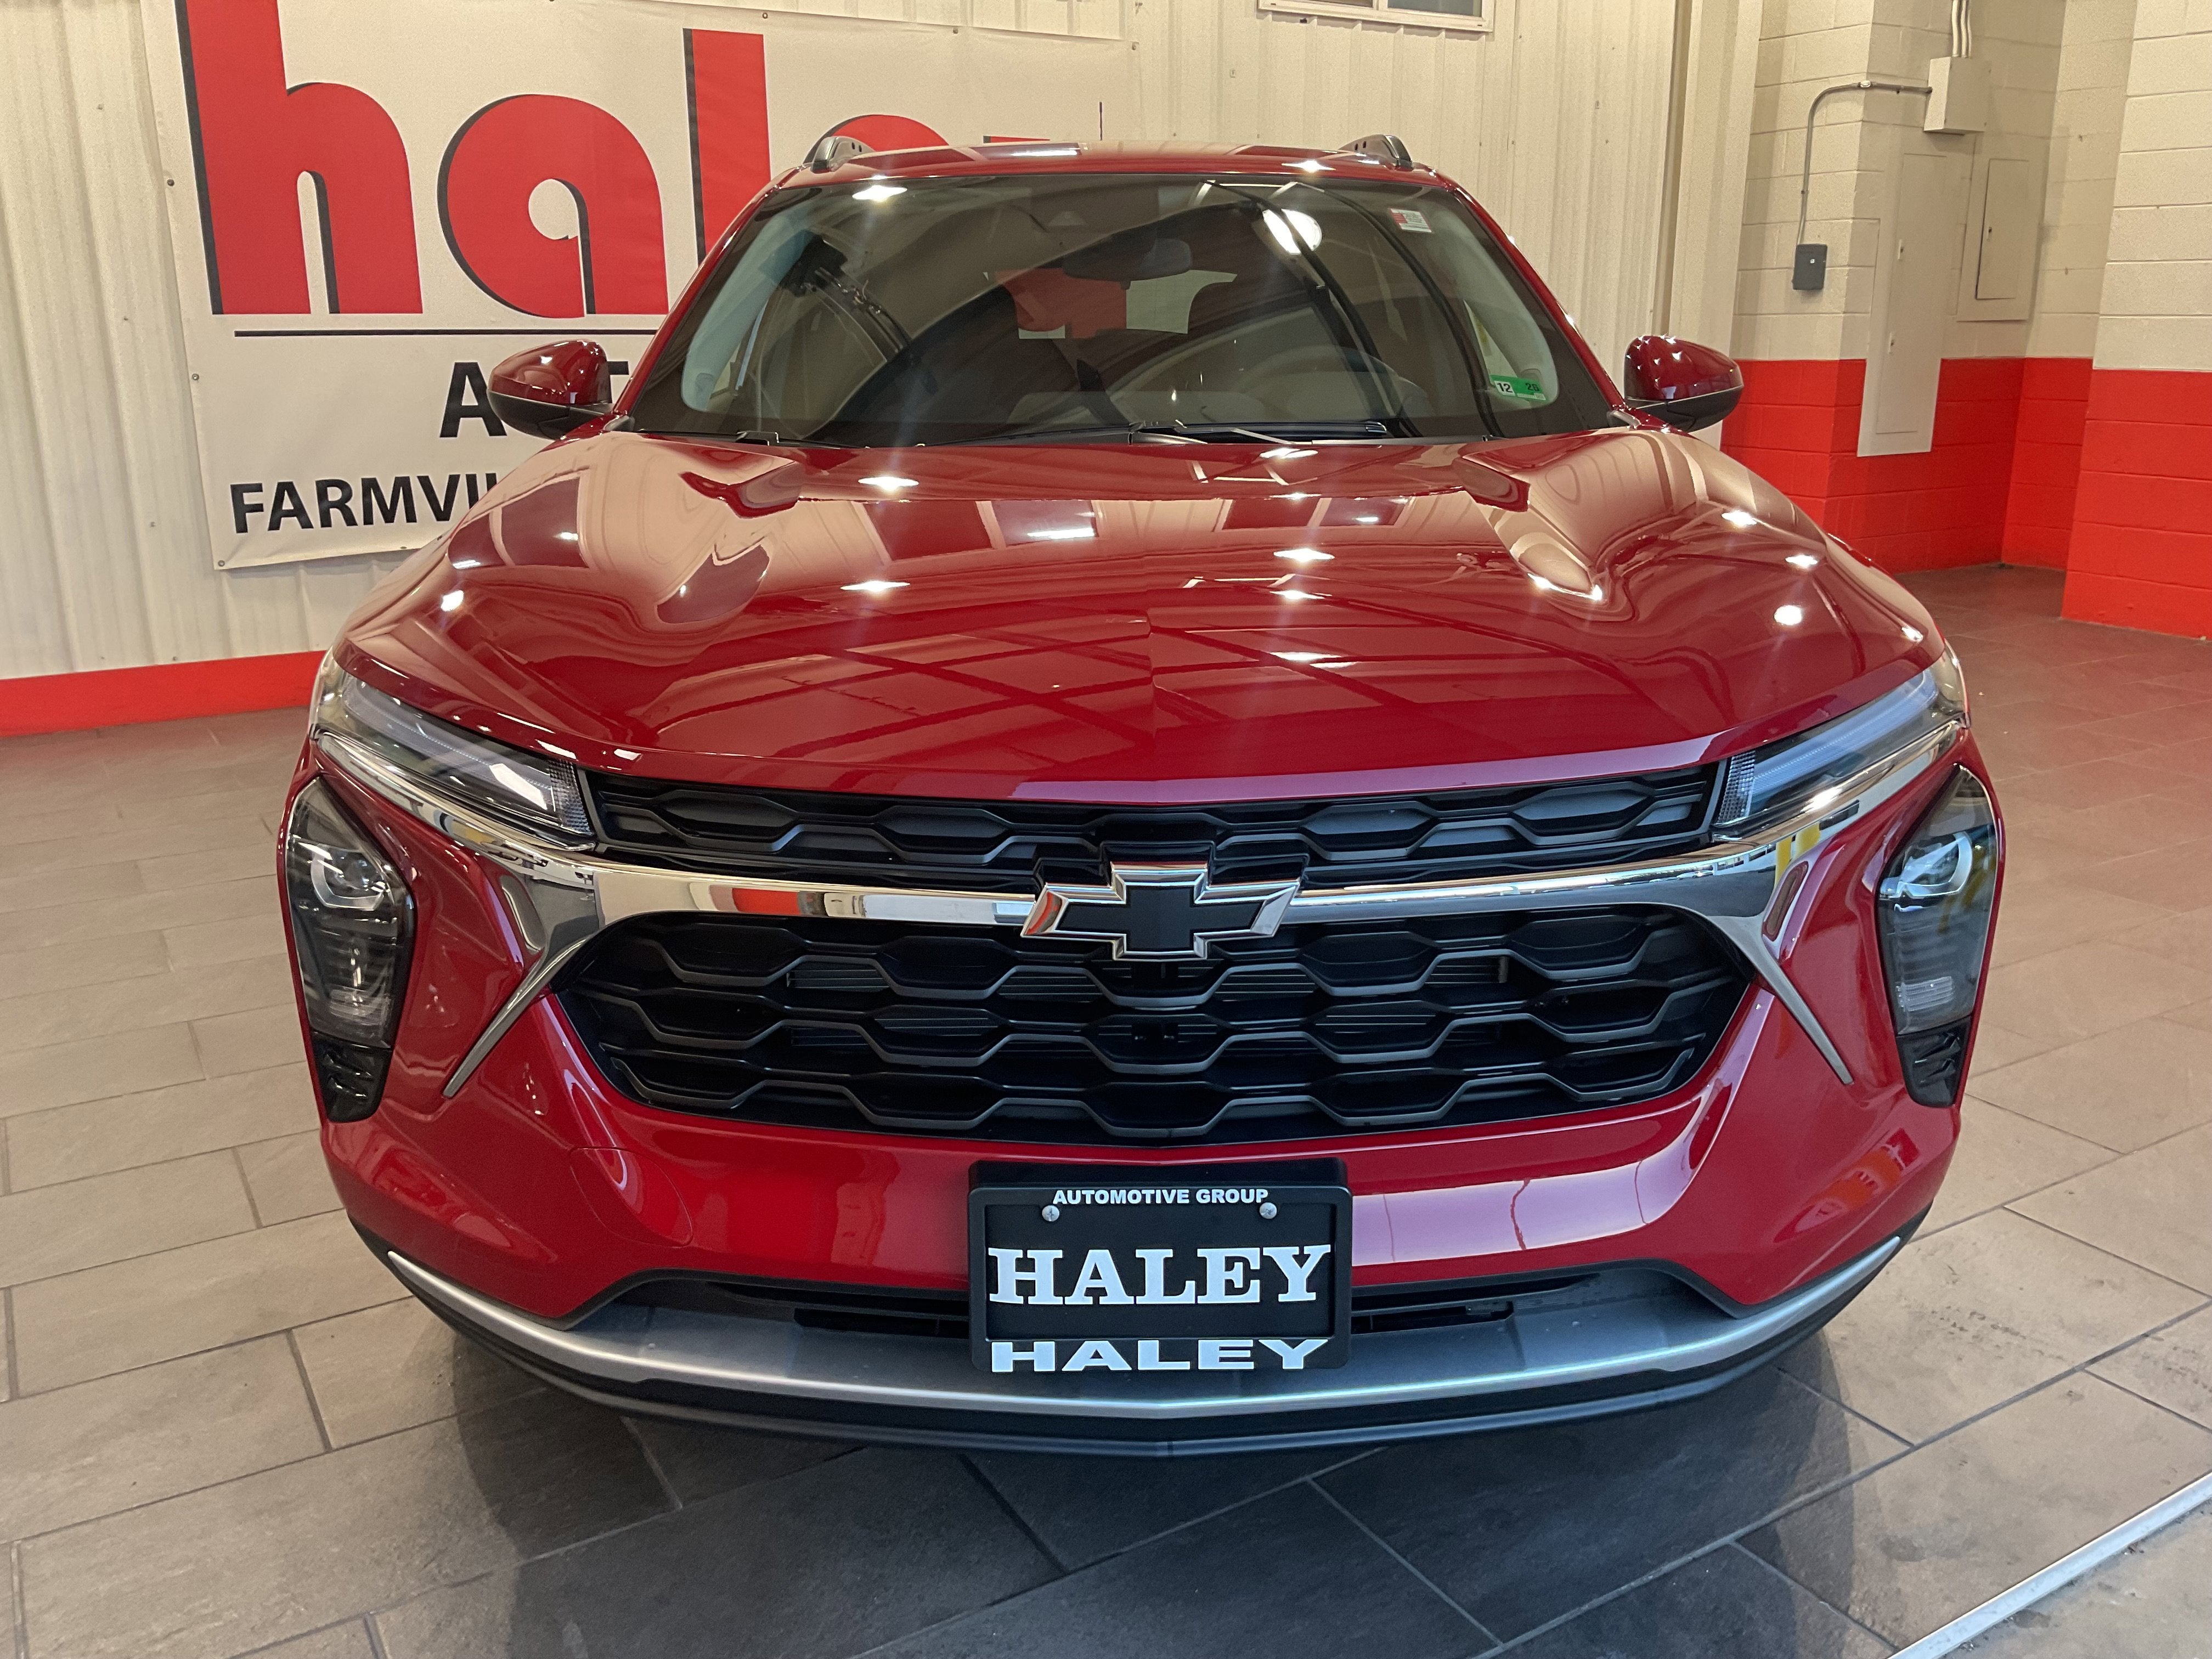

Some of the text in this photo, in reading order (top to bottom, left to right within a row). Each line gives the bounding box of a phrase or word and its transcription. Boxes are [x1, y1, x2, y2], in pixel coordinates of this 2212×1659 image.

[174, 0, 1051, 319] hal
[1496, 382, 1513, 393] 12
[230, 472, 498, 534] FARMVI
[1052, 1188, 1268, 1205] AUTOMOTIVE GROUP
[988, 1244, 1331, 1305] HALEY
[991, 1339, 1329, 1373] HALEY
